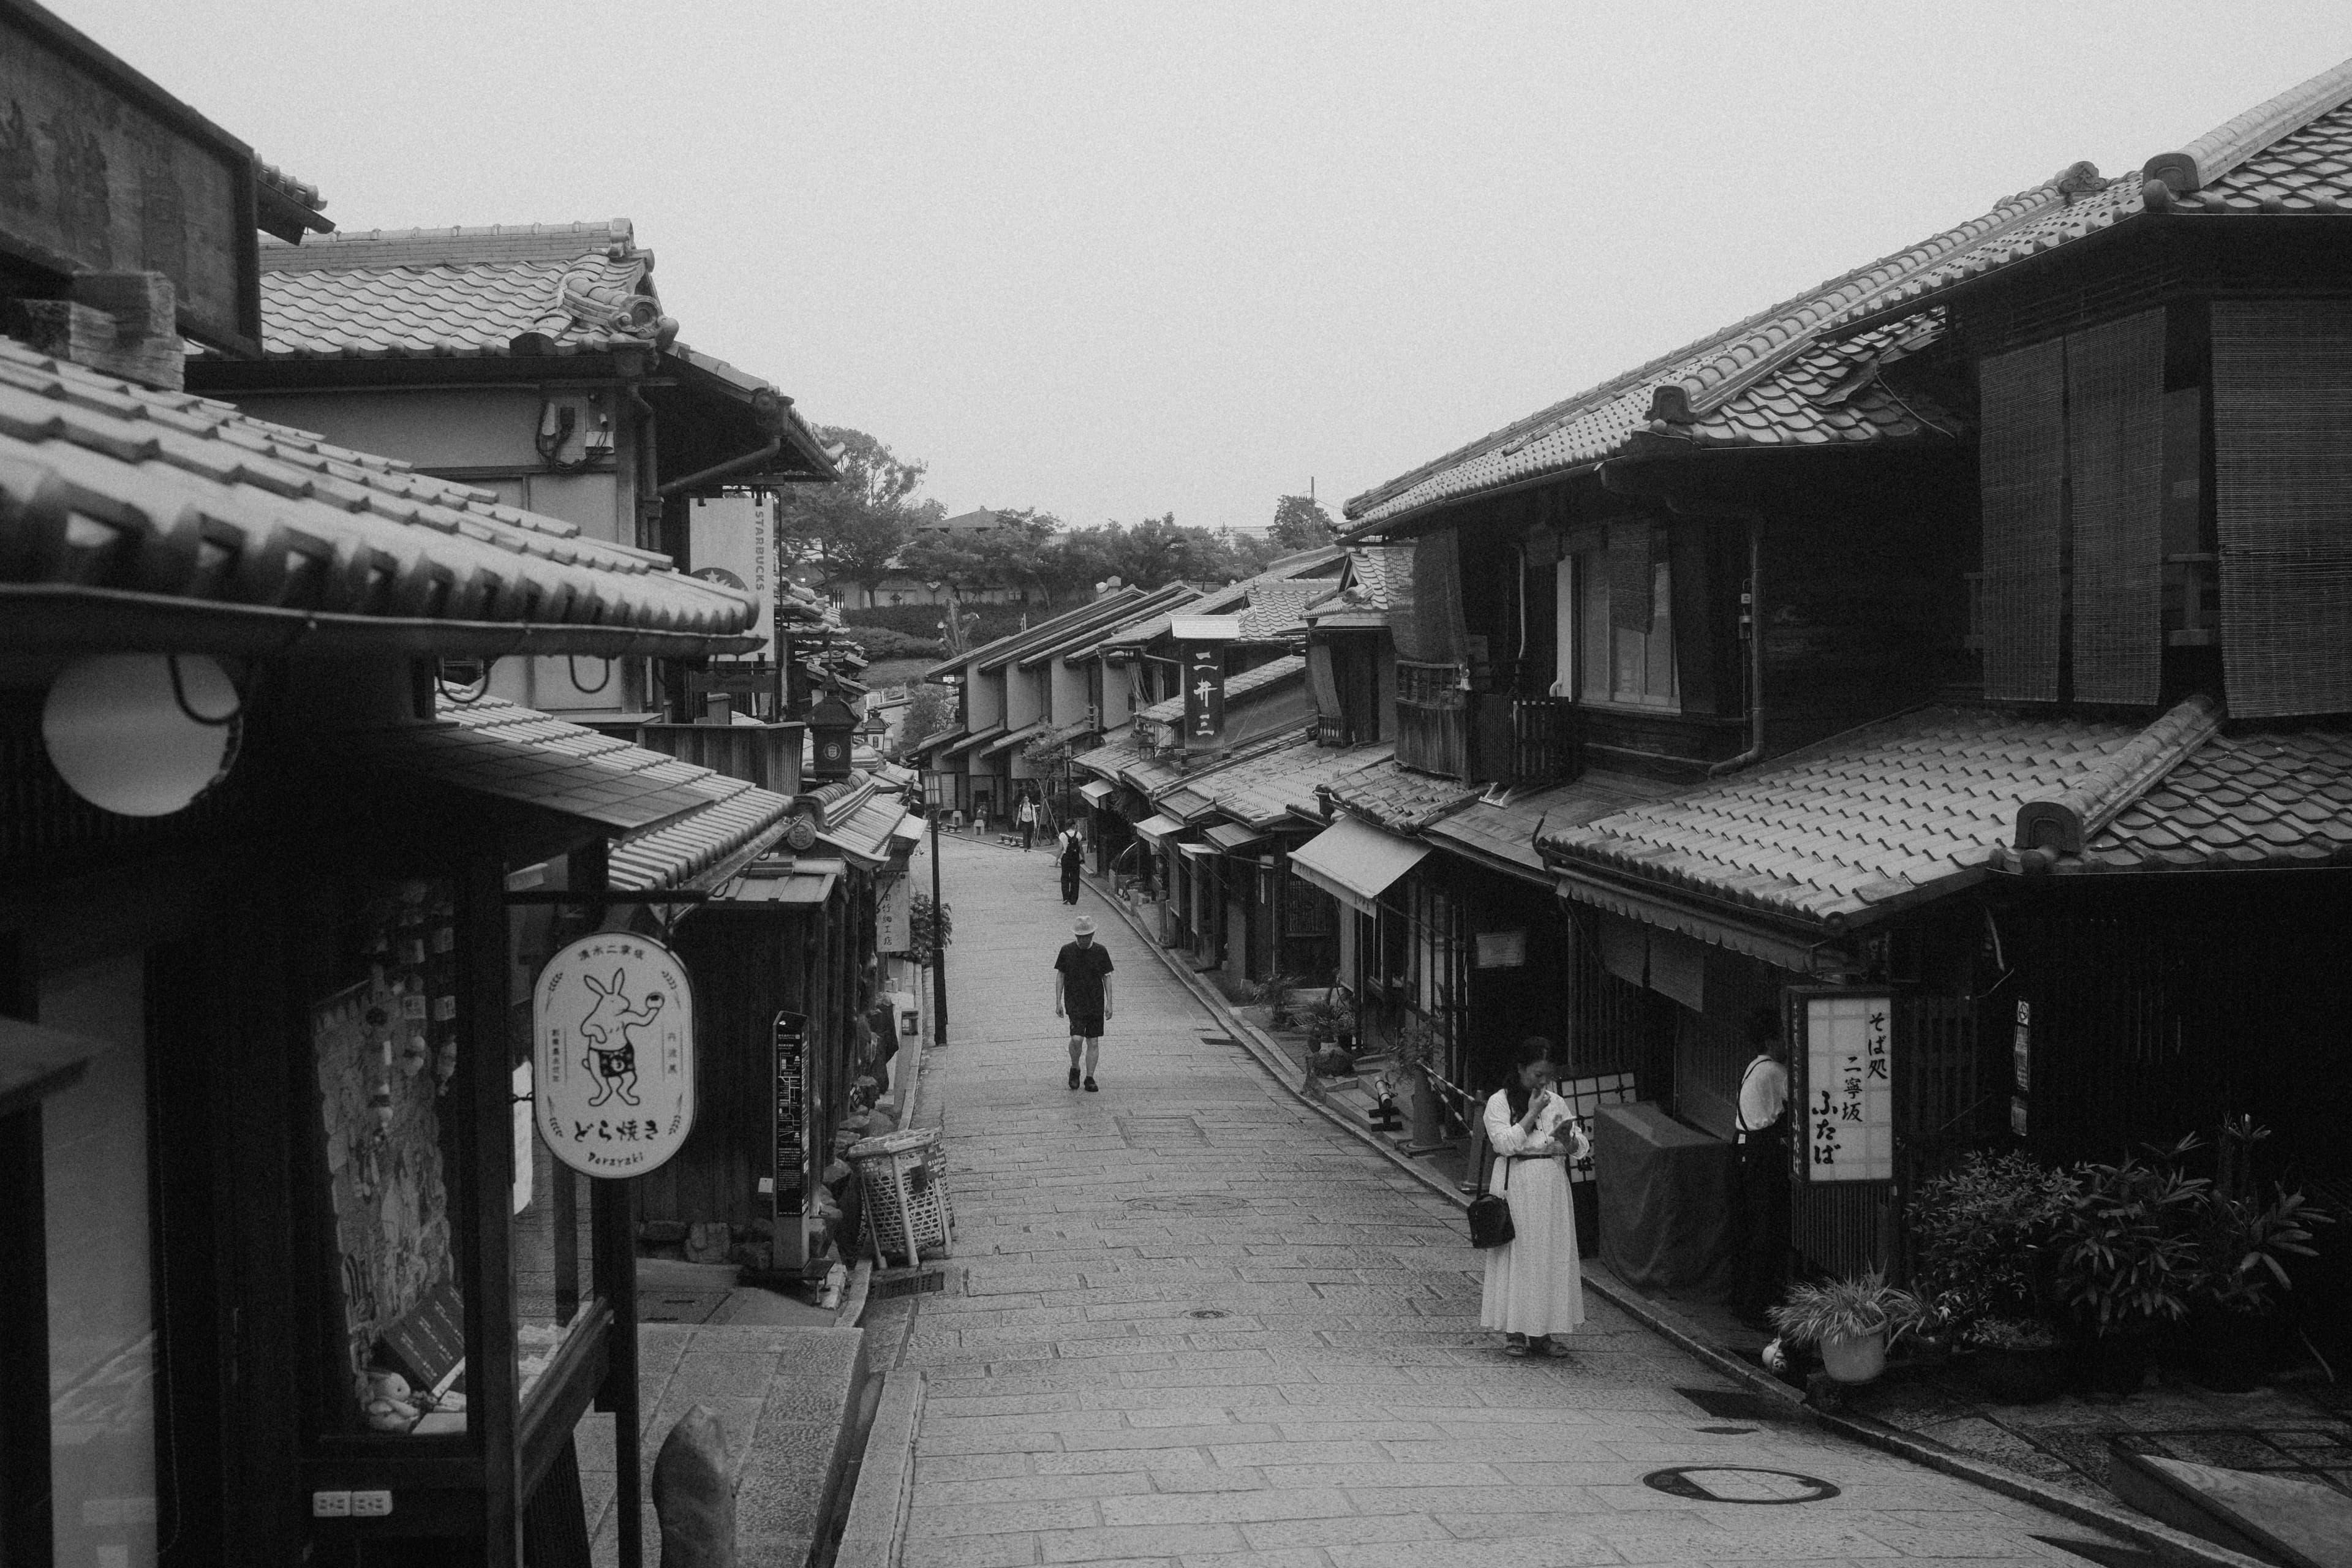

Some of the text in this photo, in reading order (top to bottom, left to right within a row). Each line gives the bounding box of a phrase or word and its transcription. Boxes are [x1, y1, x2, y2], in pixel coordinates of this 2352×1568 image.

[755, 511, 764, 591] STARBUCKS
[1868, 1012, 1888, 1079] そば処
[1842, 1056, 1863, 1122] 二寧坂
[573, 1120, 658, 1142] どら焼き
[1812, 1090, 1841, 1165] ふたば
